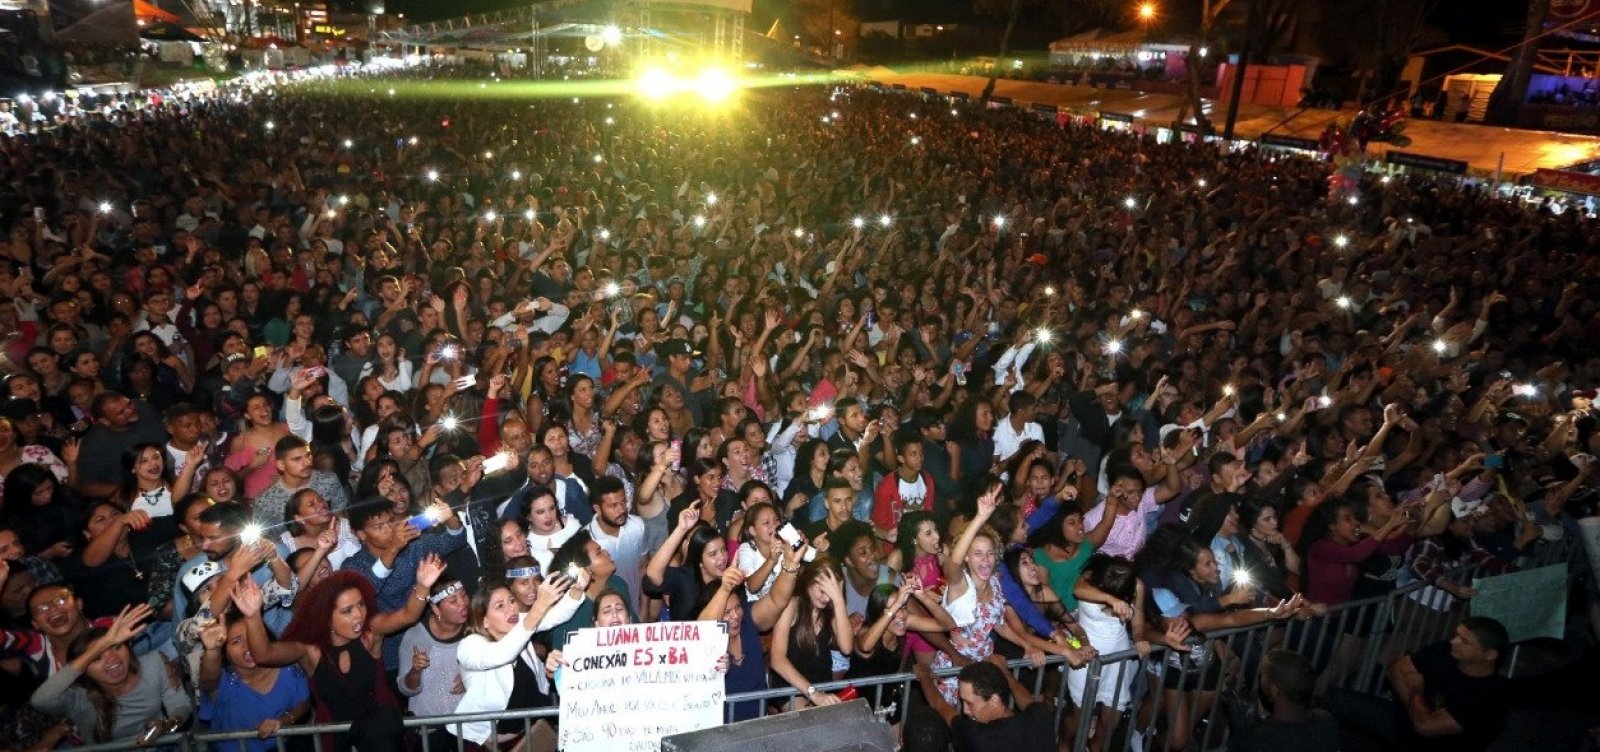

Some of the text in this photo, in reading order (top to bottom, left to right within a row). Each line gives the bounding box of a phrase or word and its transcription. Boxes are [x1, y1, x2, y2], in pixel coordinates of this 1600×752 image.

[597, 623, 700, 646] LUANA OLIVEIRA
[573, 650, 627, 672] CONEXÃO
[634, 647, 654, 666] ES
[668, 647, 688, 664] BA
